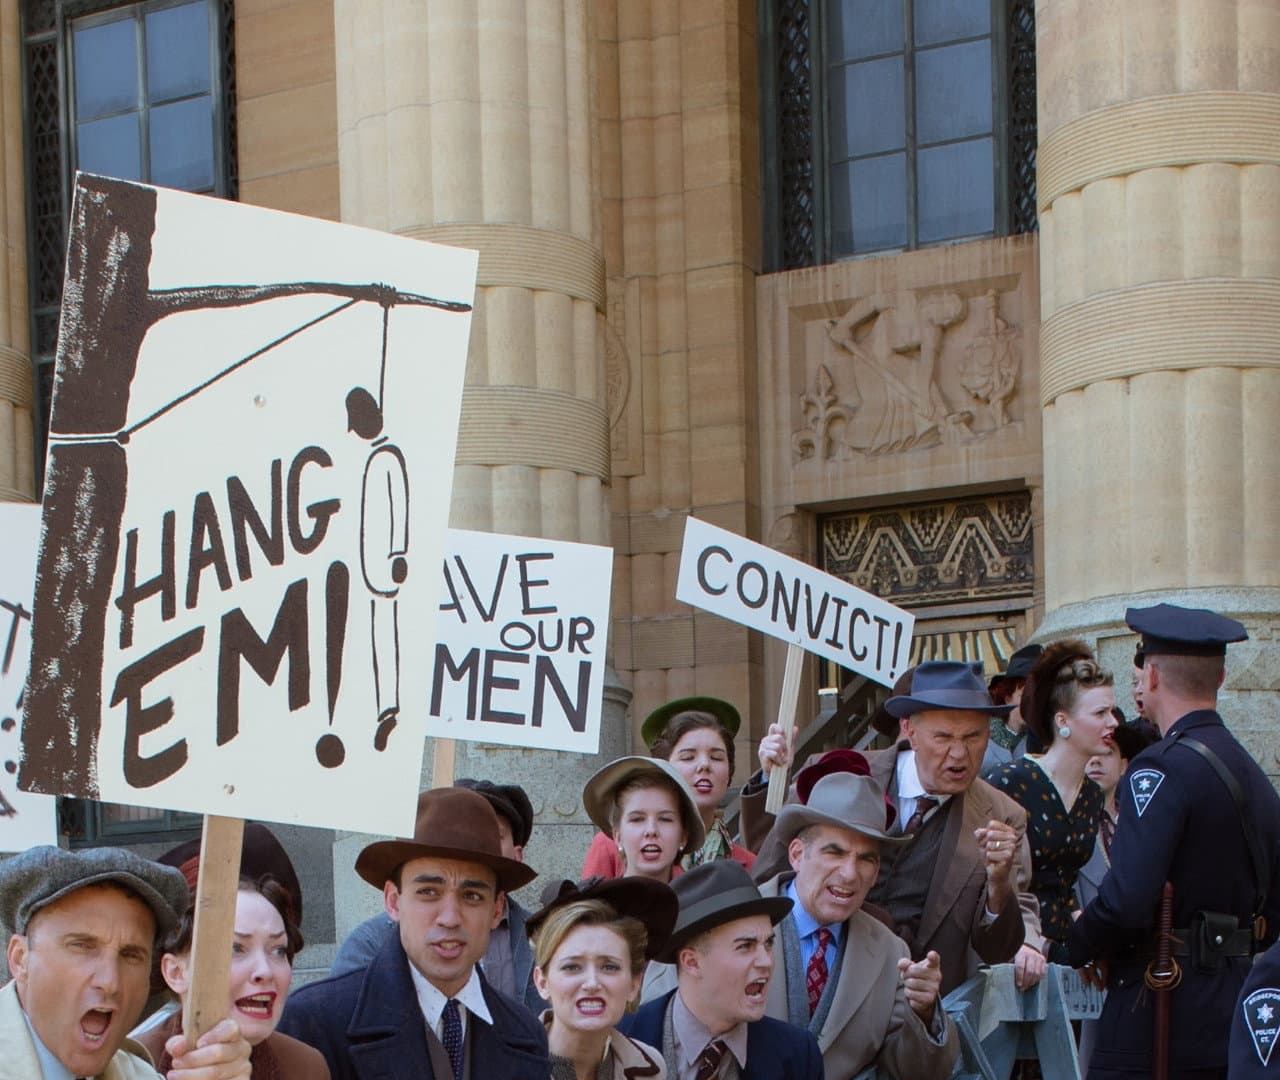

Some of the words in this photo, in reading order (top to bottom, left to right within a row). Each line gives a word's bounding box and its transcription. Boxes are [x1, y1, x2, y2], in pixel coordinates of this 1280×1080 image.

[118, 445, 341, 650] HANG
[439, 552, 558, 624] AVE
[500, 616, 596, 654] OUR
[696, 545, 903, 679] CONVICT!
[110, 560, 350, 790] EM!
[429, 643, 593, 733] MEN
